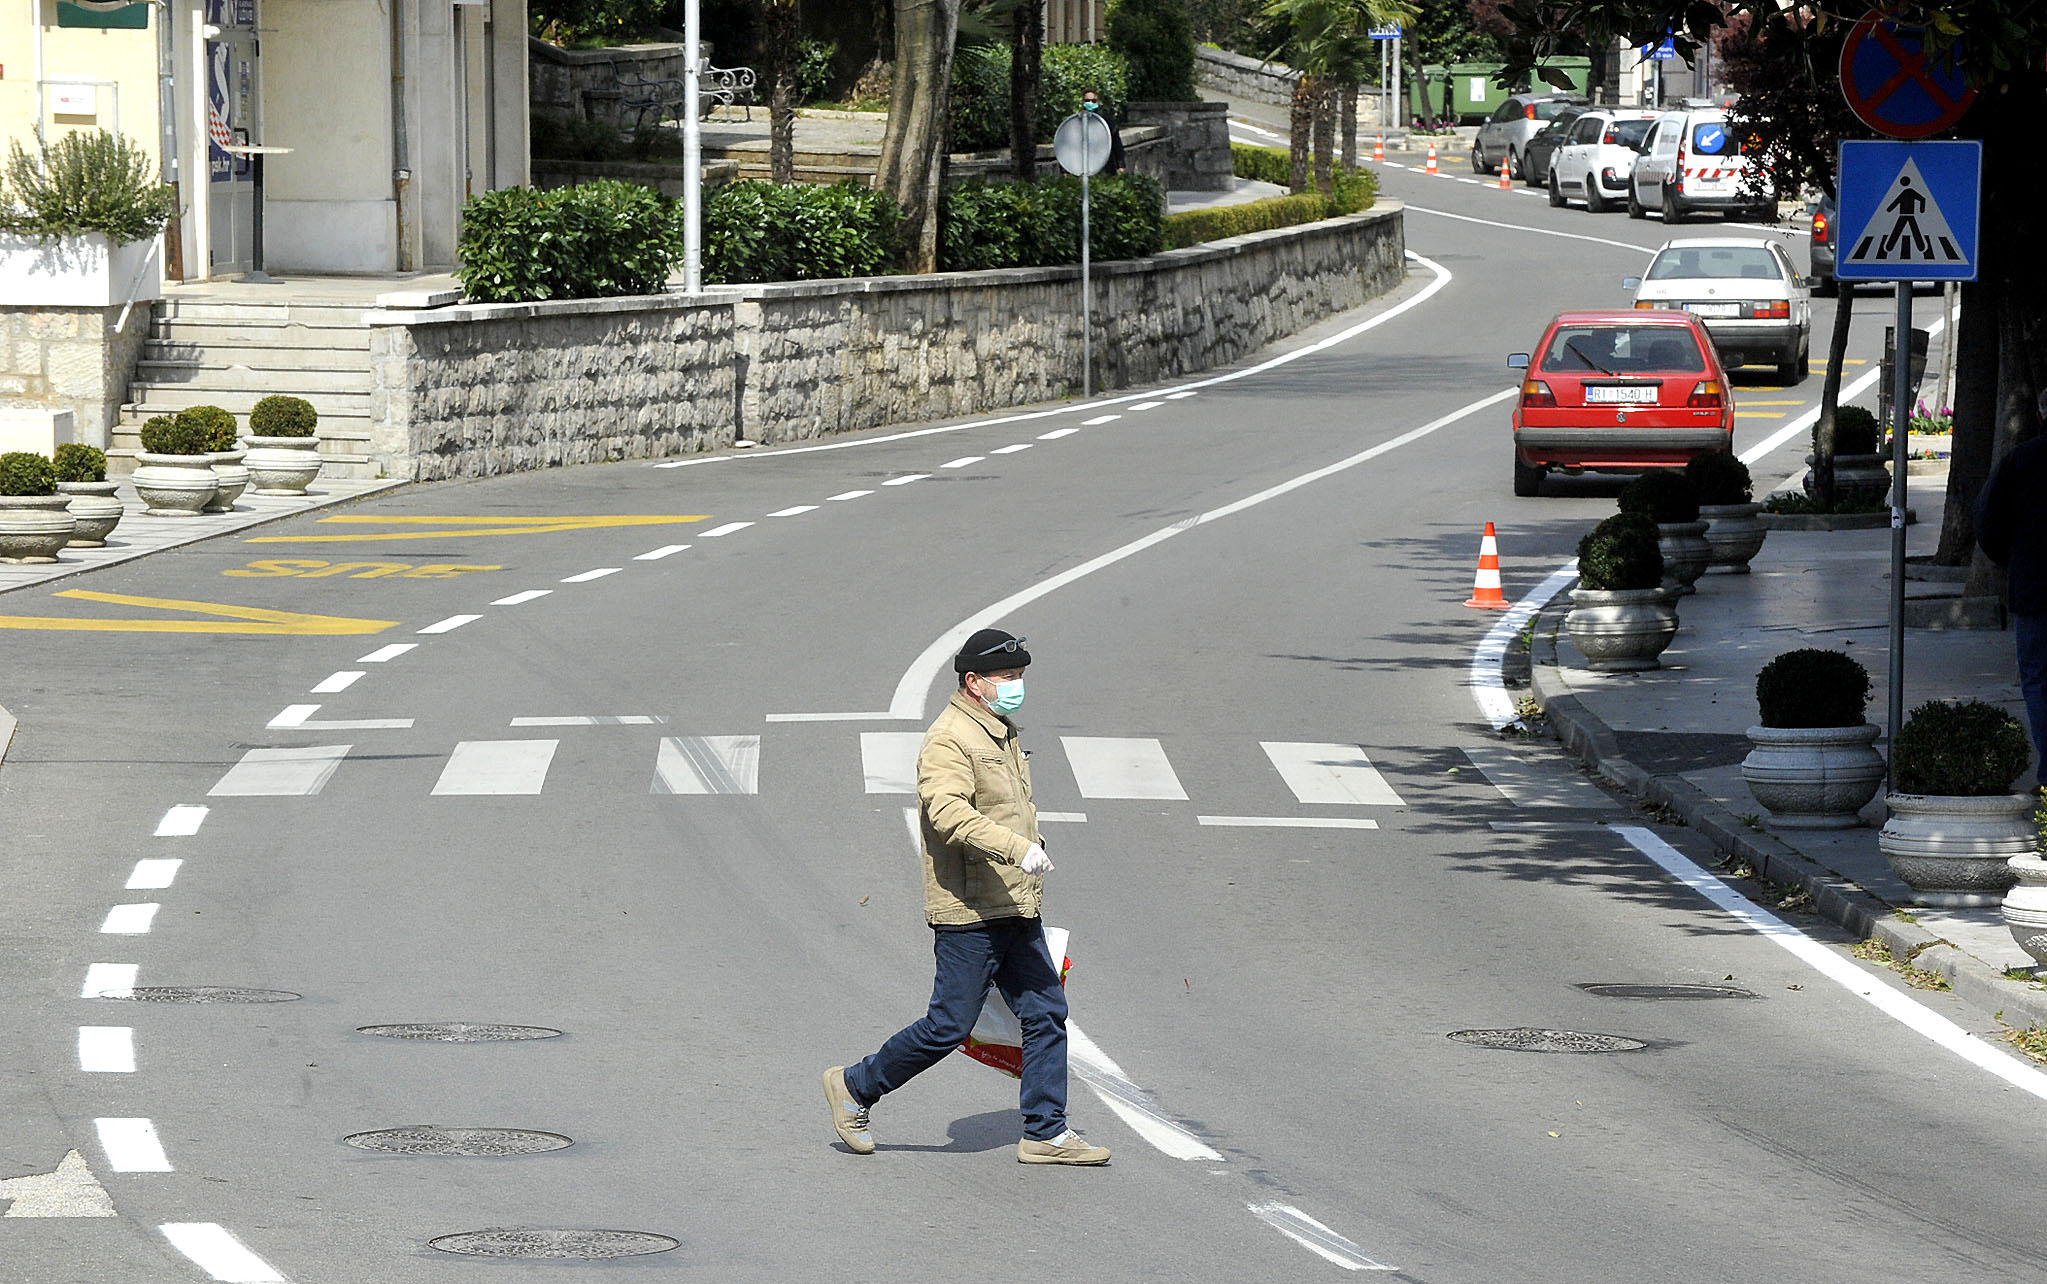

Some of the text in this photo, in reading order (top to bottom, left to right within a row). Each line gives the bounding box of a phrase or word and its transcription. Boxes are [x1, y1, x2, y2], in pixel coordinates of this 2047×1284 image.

[1594, 389, 1606, 399] RI
[1616, 389, 1641, 400] 1540
[221, 559, 503, 579] BUS
